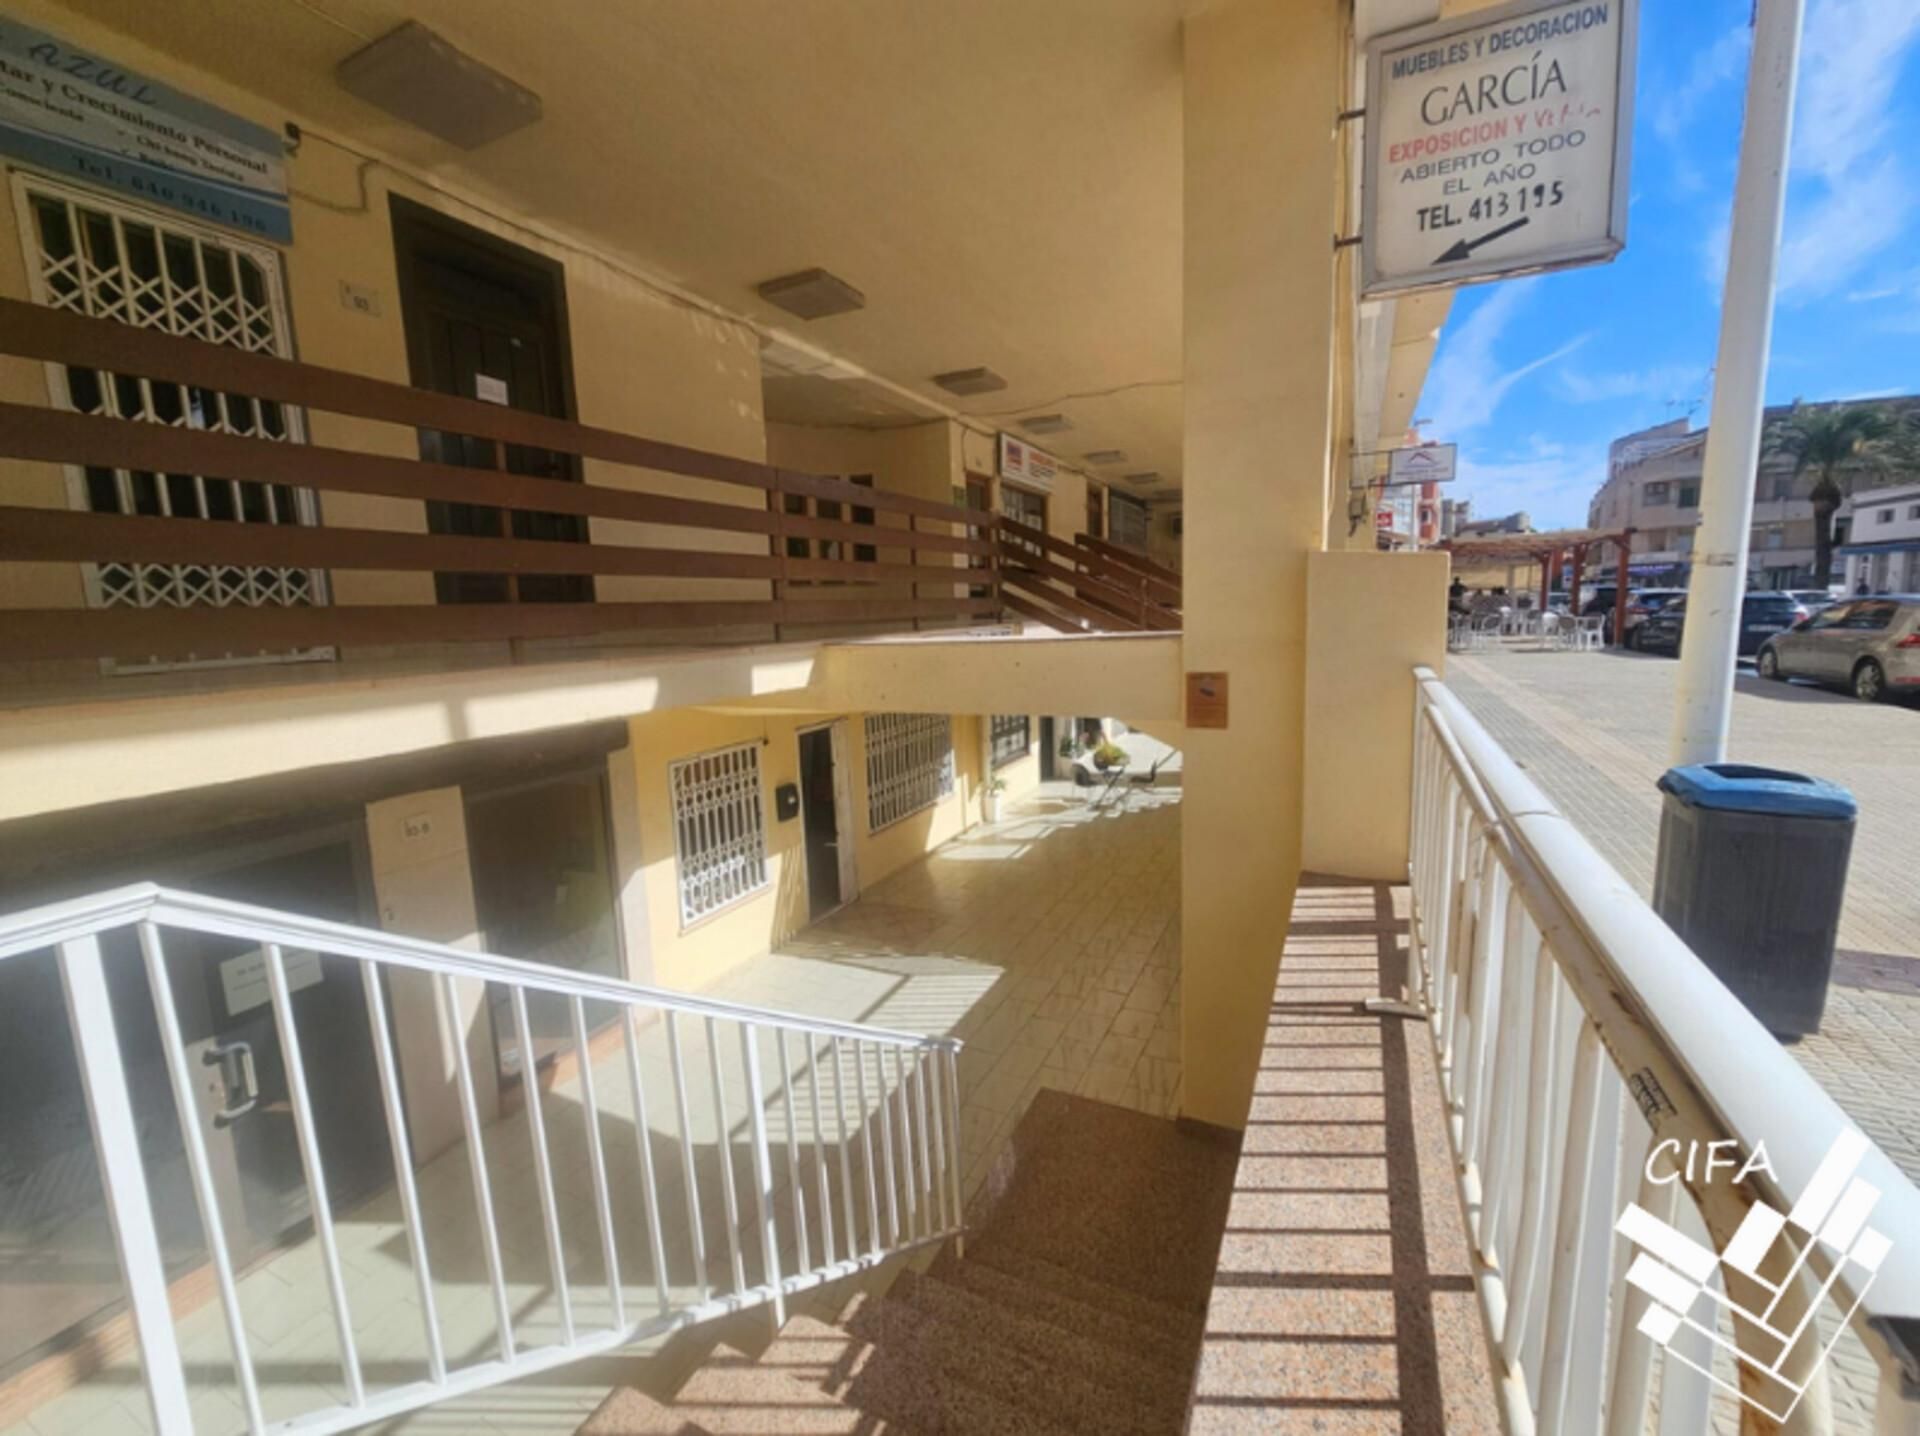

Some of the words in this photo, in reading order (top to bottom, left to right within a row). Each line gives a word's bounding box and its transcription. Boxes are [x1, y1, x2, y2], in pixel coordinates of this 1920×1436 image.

[1392, 41, 1470, 79] MUEBLES
[1473, 37, 1486, 57] Y
[1490, 4, 1608, 53] DECORACION
[29, 42, 156, 105] AZUL
[1421, 50, 1567, 126] GARCÍA
[61, 84, 188, 144] Crecimiento
[192, 136, 269, 175] Personal
[1388, 120, 1508, 163] EXPOSICION
[1513, 112, 1527, 133] Y
[1401, 149, 1500, 183] ABIERTO
[1514, 130, 1586, 158] TODO
[1443, 179, 1471, 196] EL
[1483, 162, 1537, 188] AÑO
[1417, 205, 1462, 232] TEL.
